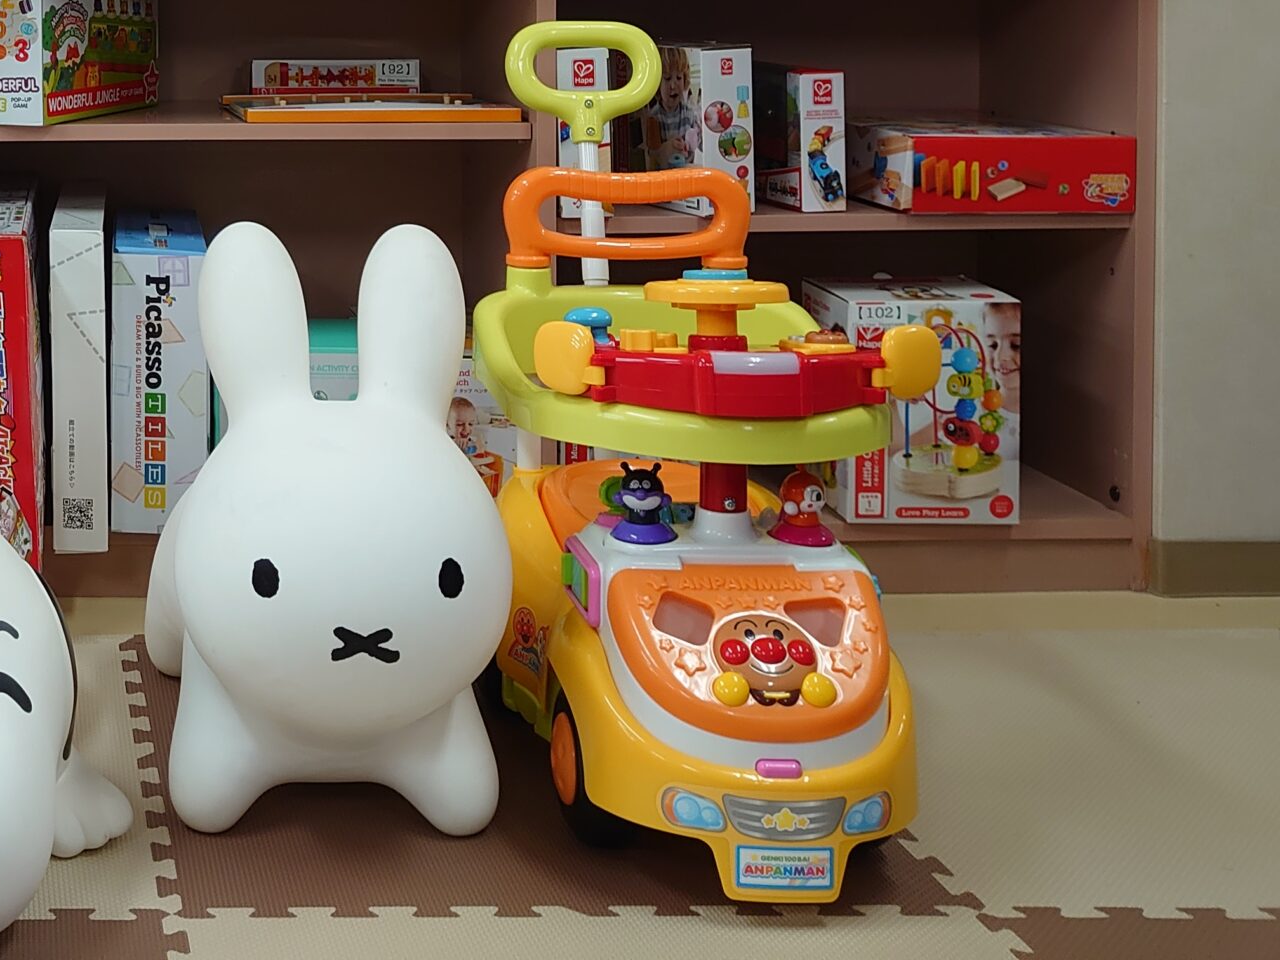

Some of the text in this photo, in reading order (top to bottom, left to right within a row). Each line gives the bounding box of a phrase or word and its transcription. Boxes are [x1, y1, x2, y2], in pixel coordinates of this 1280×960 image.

[381, 63, 410, 75] 【92】
[575, 77, 594, 85] Hape
[48, 91, 94, 112] WONDERFUL
[95, 88, 120, 105] JUNGLE
[814, 95, 832, 103] Hape
[858, 306, 902, 319] 【102】
[145, 275, 170, 389] Picasso
[923, 509, 940, 517] Play
[679, 575, 812, 592] ANPANMAN
[743, 864, 826, 878] ANPANMAN
